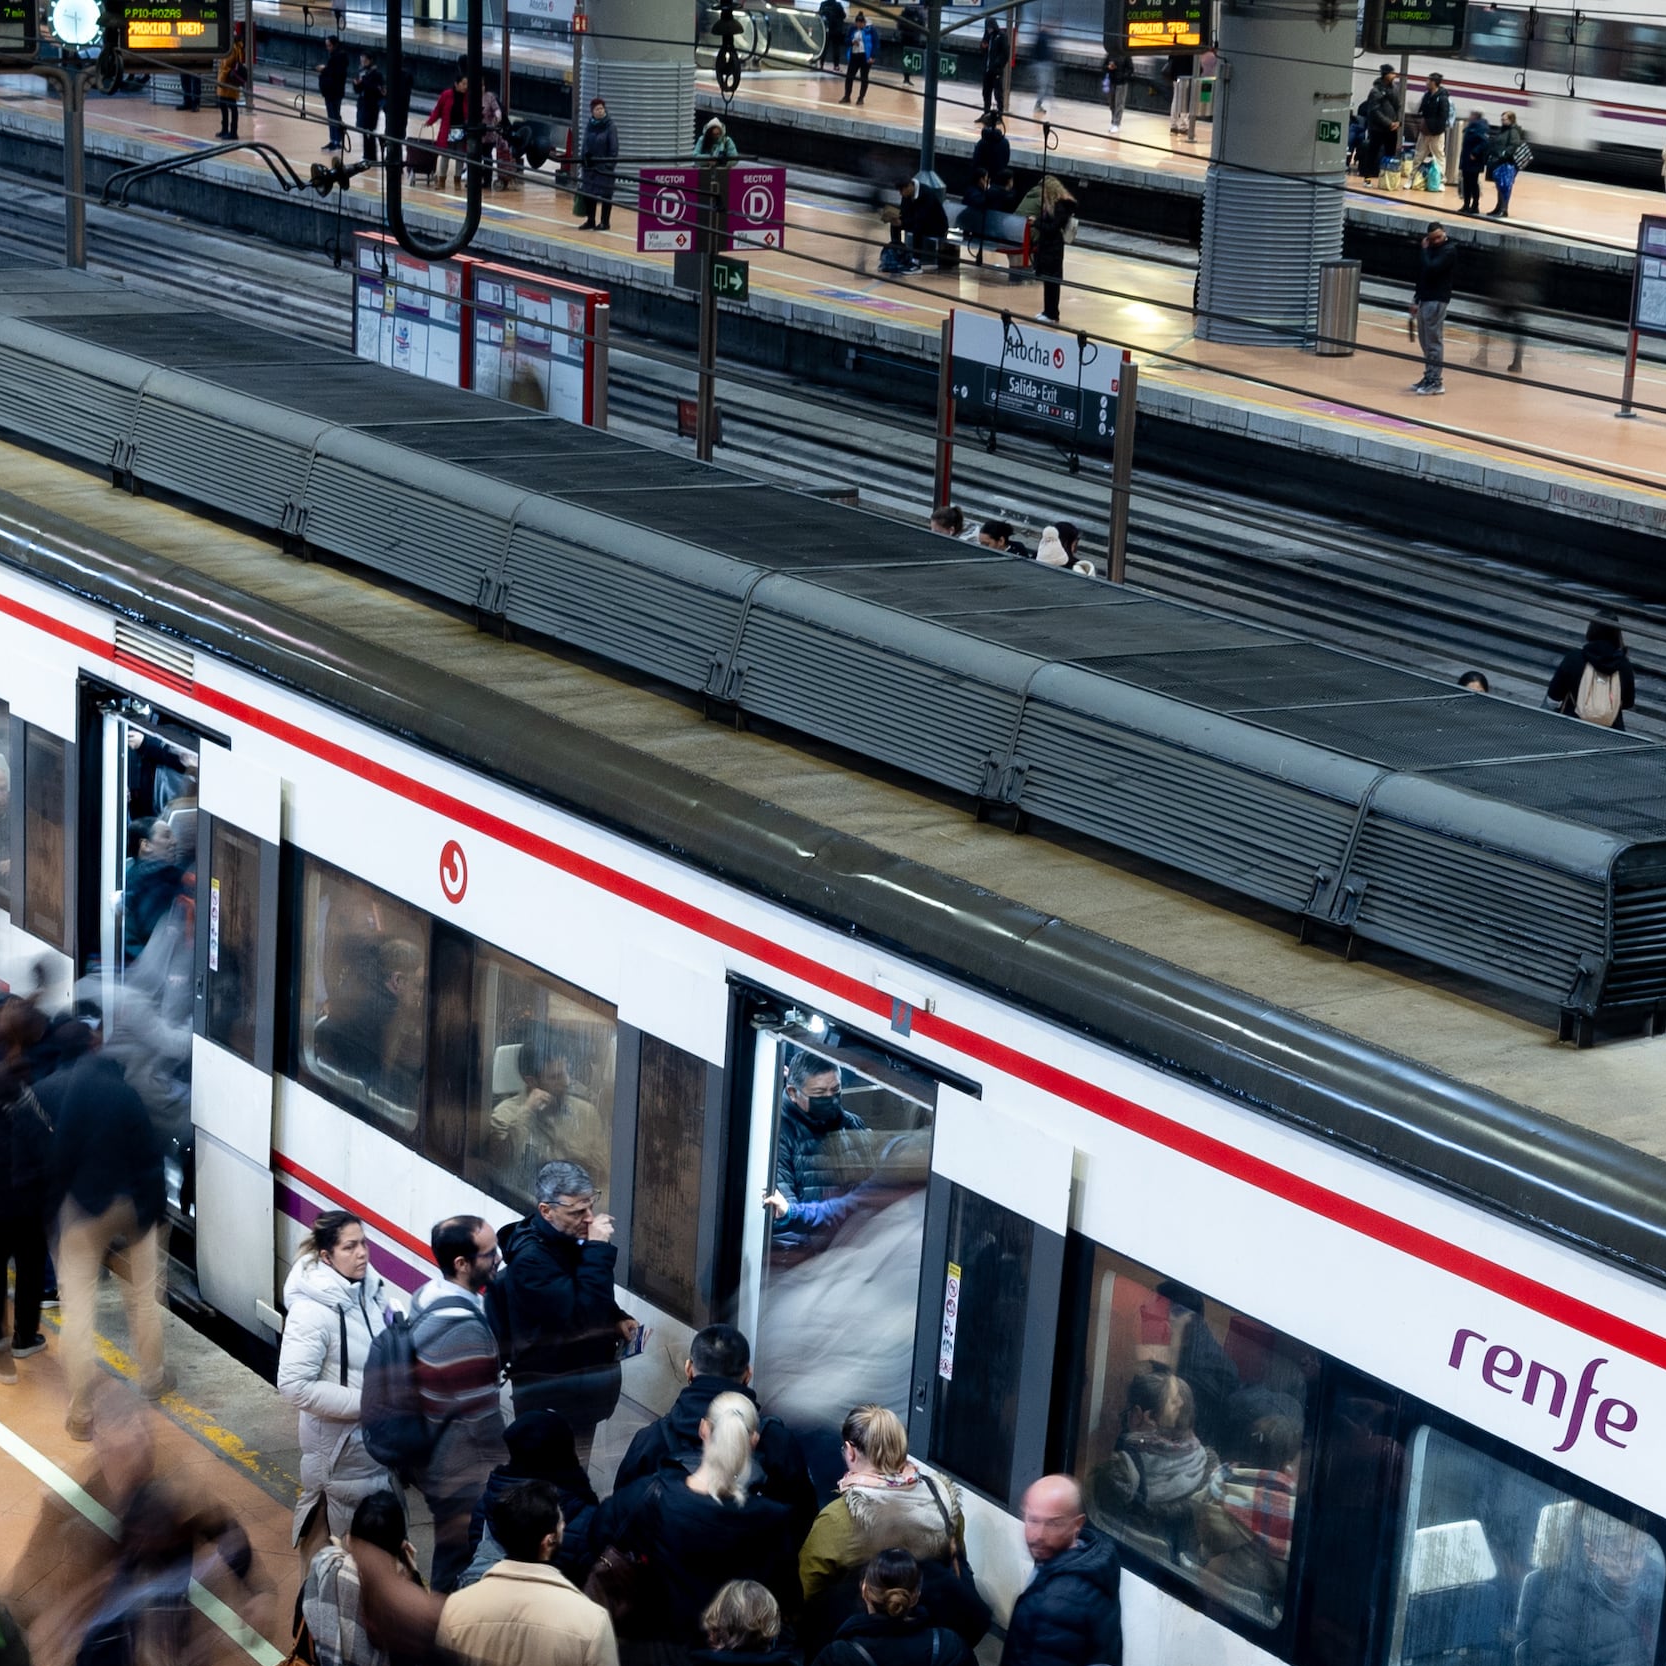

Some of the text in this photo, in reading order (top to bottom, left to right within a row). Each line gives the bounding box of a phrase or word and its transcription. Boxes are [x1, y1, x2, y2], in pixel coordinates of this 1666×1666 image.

[743, 174, 773, 184] SECTOR
[660, 192, 681, 218] D
[749, 191, 769, 218] D
[1005, 335, 1051, 367] Atocha
[1448, 1328, 1638, 1453] renfe
